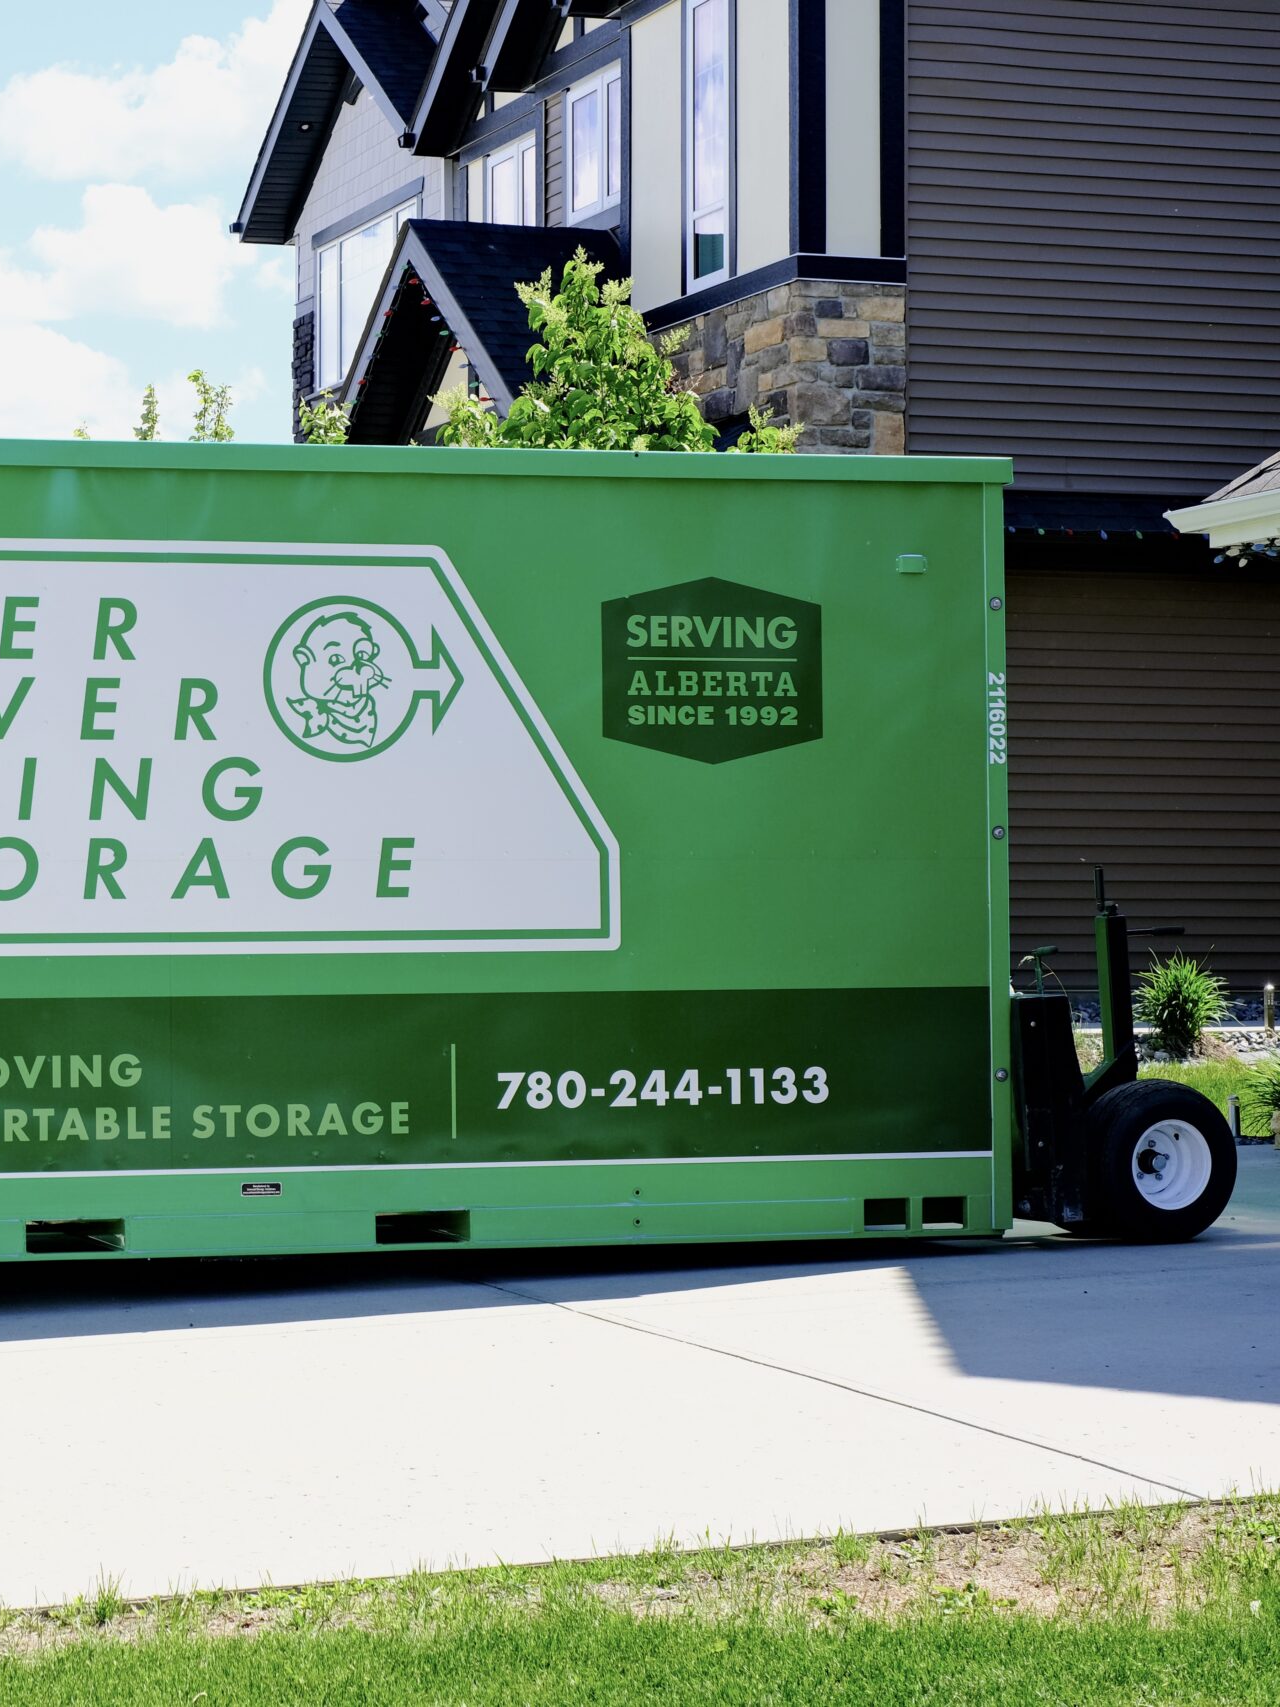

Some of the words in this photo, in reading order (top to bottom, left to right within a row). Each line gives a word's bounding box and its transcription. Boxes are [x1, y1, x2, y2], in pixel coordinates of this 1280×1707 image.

[626, 614, 798, 650] SERVING
[627, 670, 798, 697] ALBERTA
[627, 704, 714, 726] SINCE
[725, 705, 798, 726] 1992
[988, 671, 1007, 765] 2116022
[497, 1066, 829, 1110] 780-244-1133
[192, 1101, 409, 1139] STORAGE
